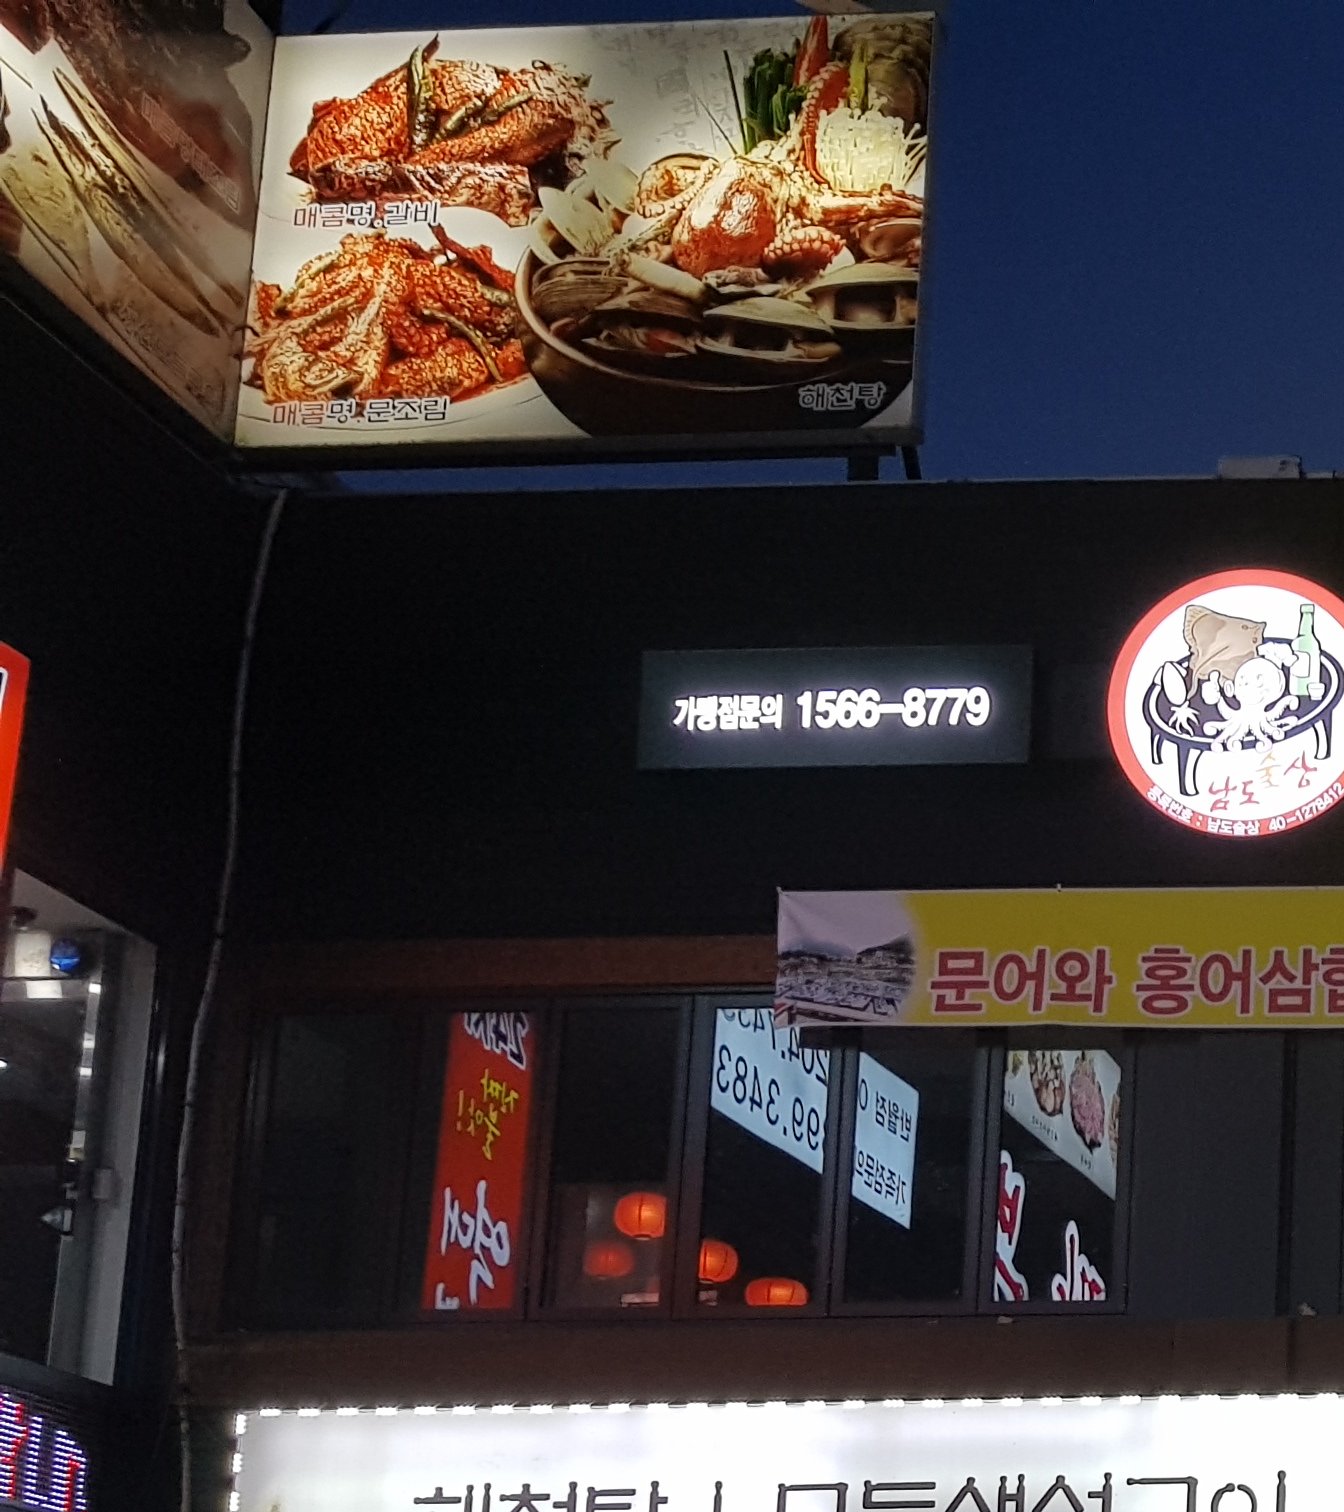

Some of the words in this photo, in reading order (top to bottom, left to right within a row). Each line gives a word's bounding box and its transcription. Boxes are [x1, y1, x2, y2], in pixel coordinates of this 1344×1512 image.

[799, 382, 887, 411] 해천탕
[797, 687, 990, 728] 1566-8779
[929, 947, 1113, 1016] 문어와
